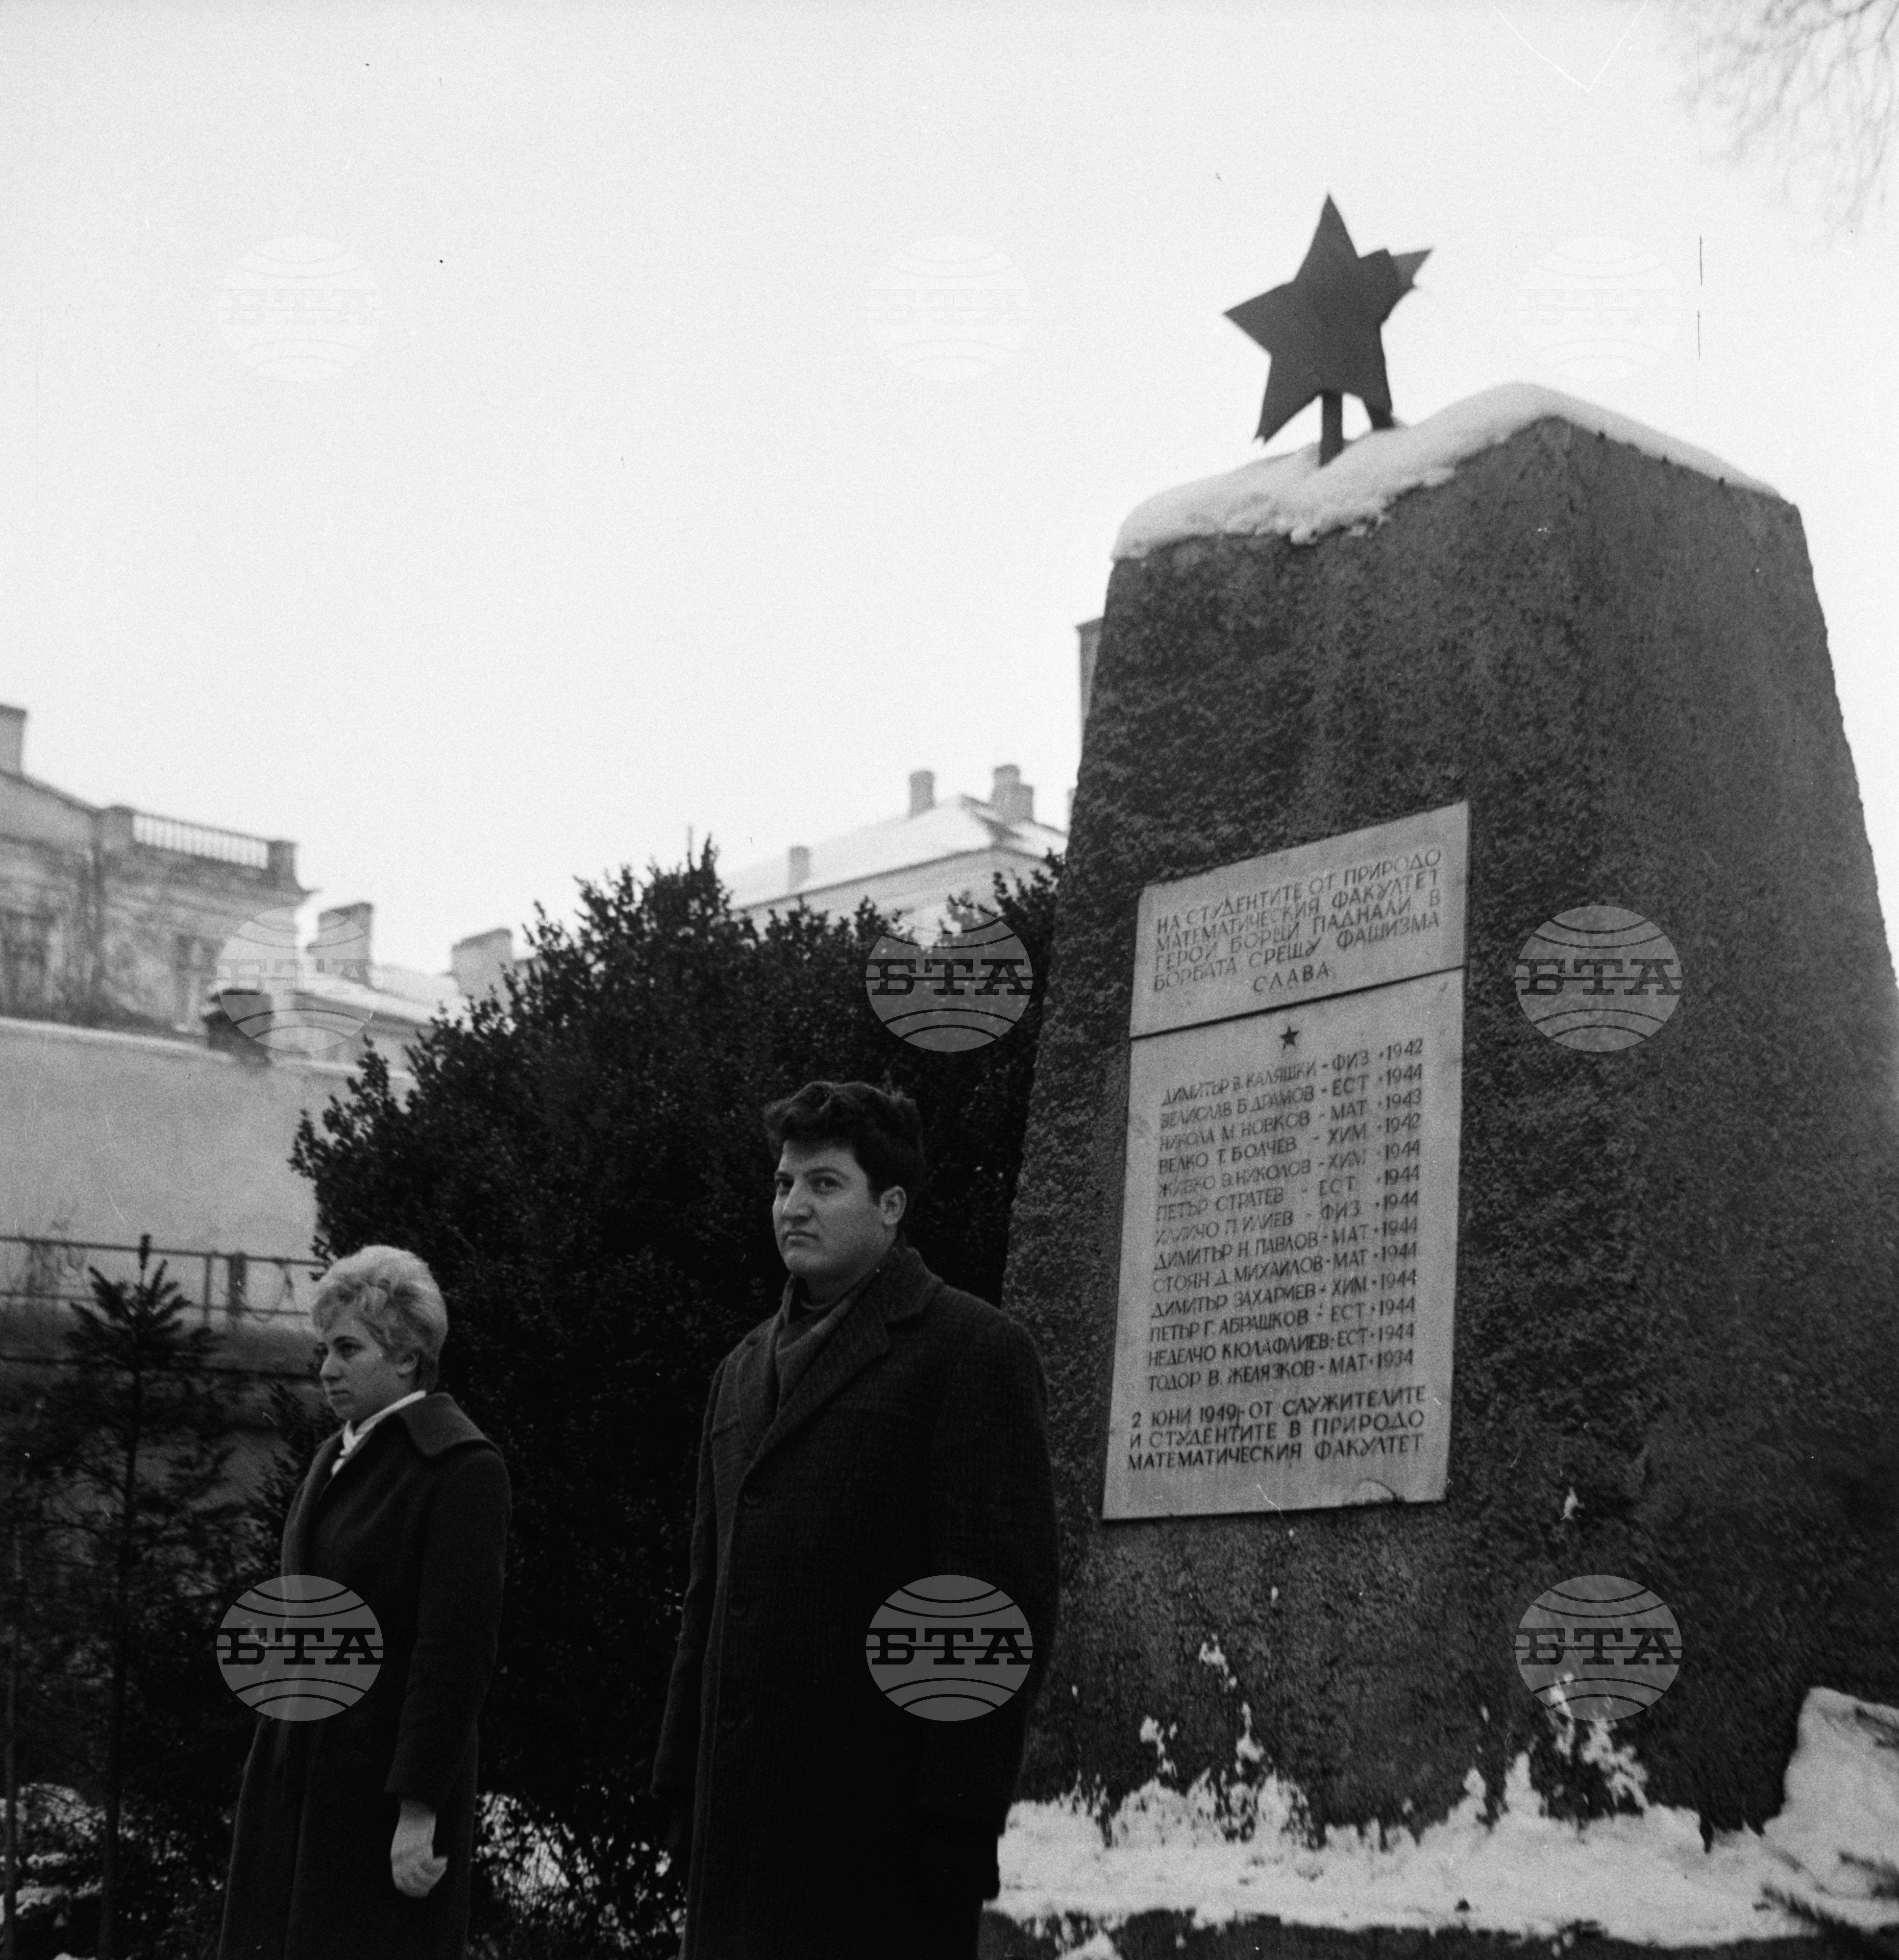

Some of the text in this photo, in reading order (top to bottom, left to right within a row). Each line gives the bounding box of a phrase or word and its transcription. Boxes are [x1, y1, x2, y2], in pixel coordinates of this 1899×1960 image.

[1156, 868, 1438, 952] МАТЕМАТИЧЕСКИЯ ФАКУЛТЕТ
[1157, 849, 1441, 934] НА СТУДЕНТИТЕ ОТ ПРИРОДО
[1313, 897, 1411, 935] ПАДНАЛИ
[1430, 888, 1440, 907] В
[1153, 911, 1439, 993] БОРБАТА СРЕЩУ ФАШИЗМА
[1253, 961, 1330, 993] СЛАВА
[1160, 1078, 1230, 1107] ДИМИТЪР
[1332, 1073, 1370, 1097] ЕСТ
[1159, 1128, 1215, 1152] НИКОЛА
[1331, 1098, 1368, 1121] МАТ
[1159, 1152, 1209, 1175] ВЕЛКО
[1231, 1136, 1297, 1162] БОЛЧЕВ
[1215, 1187, 1284, 1212] СТРАТЕВ
[1319, 1176, 1356, 1197] ЕСТ
[1320, 1200, 1360, 1223] ФИЗ
[1153, 1243, 1233, 1271] ДИМИТЪР
[1255, 1231, 1319, 1255] ПАВЛОВ
[1332, 1224, 1369, 1245] МАТ
[1153, 1271, 1209, 1293] СТОЯН
[1333, 1248, 1368, 1270] МАТ
[1150, 1294, 1228, 1319] ДИМИТЪР
[1233, 1283, 1316, 1308] ЗАХАРИЕВ
[1332, 1275, 1367, 1297] ХИМ
[1150, 1322, 1201, 1343] ПЕТЪР
[1219, 1309, 1309, 1335] АБРАШКОВ
[1331, 1302, 1365, 1322] ЕСТ
[1148, 1345, 1216, 1368] НЕДЕЛЧО
[1337, 1327, 1368, 1347] ЕСТ
[1147, 1372, 1201, 1392] ТОДОР
[1227, 1359, 1315, 1385] ЖЕЛЯЗКОВ
[1329, 1353, 1367, 1374] МАТ
[1131, 1411, 1142, 1429] 2
[1152, 1407, 1192, 1427] ЮНИ
[1249, 1400, 1273, 1419] ОТ
[1282, 1385, 1425, 1417] СЛУЖИТЕЛИТЕ
[1129, 1409, 1425, 1450] И СТУДЕНТИТЕ В ПРИРОДО
[1128, 1433, 1424, 1468] МАТЕМАТИЧЕСКИЯ ФАКУЛТЕТ
